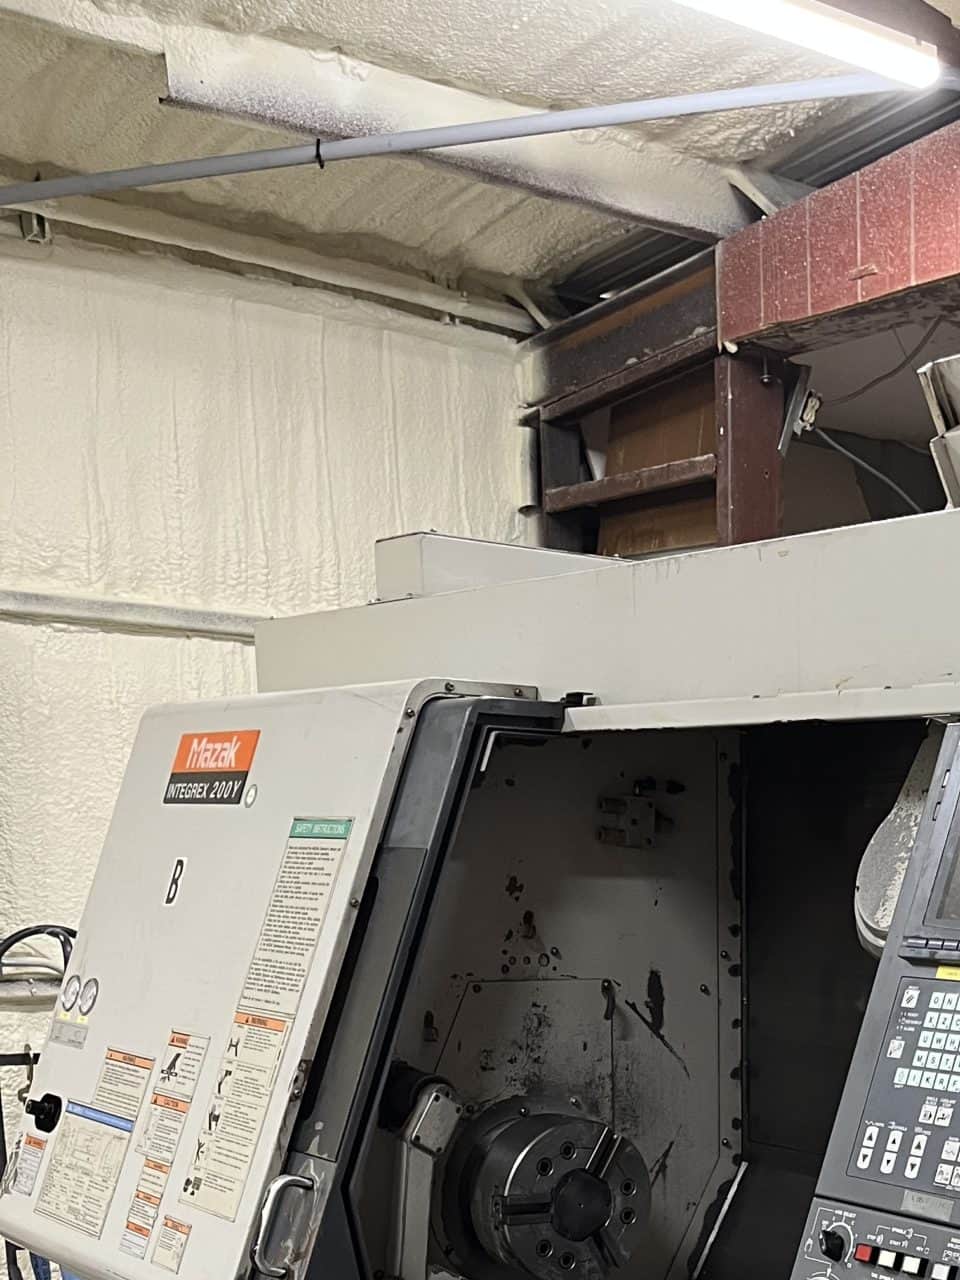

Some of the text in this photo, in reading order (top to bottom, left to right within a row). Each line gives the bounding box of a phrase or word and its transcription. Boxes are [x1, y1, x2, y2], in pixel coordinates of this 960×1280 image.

[186, 736, 242, 769] Mazak
[166, 779, 242, 800] INTEGREX 200Y
[165, 859, 184, 904] B
